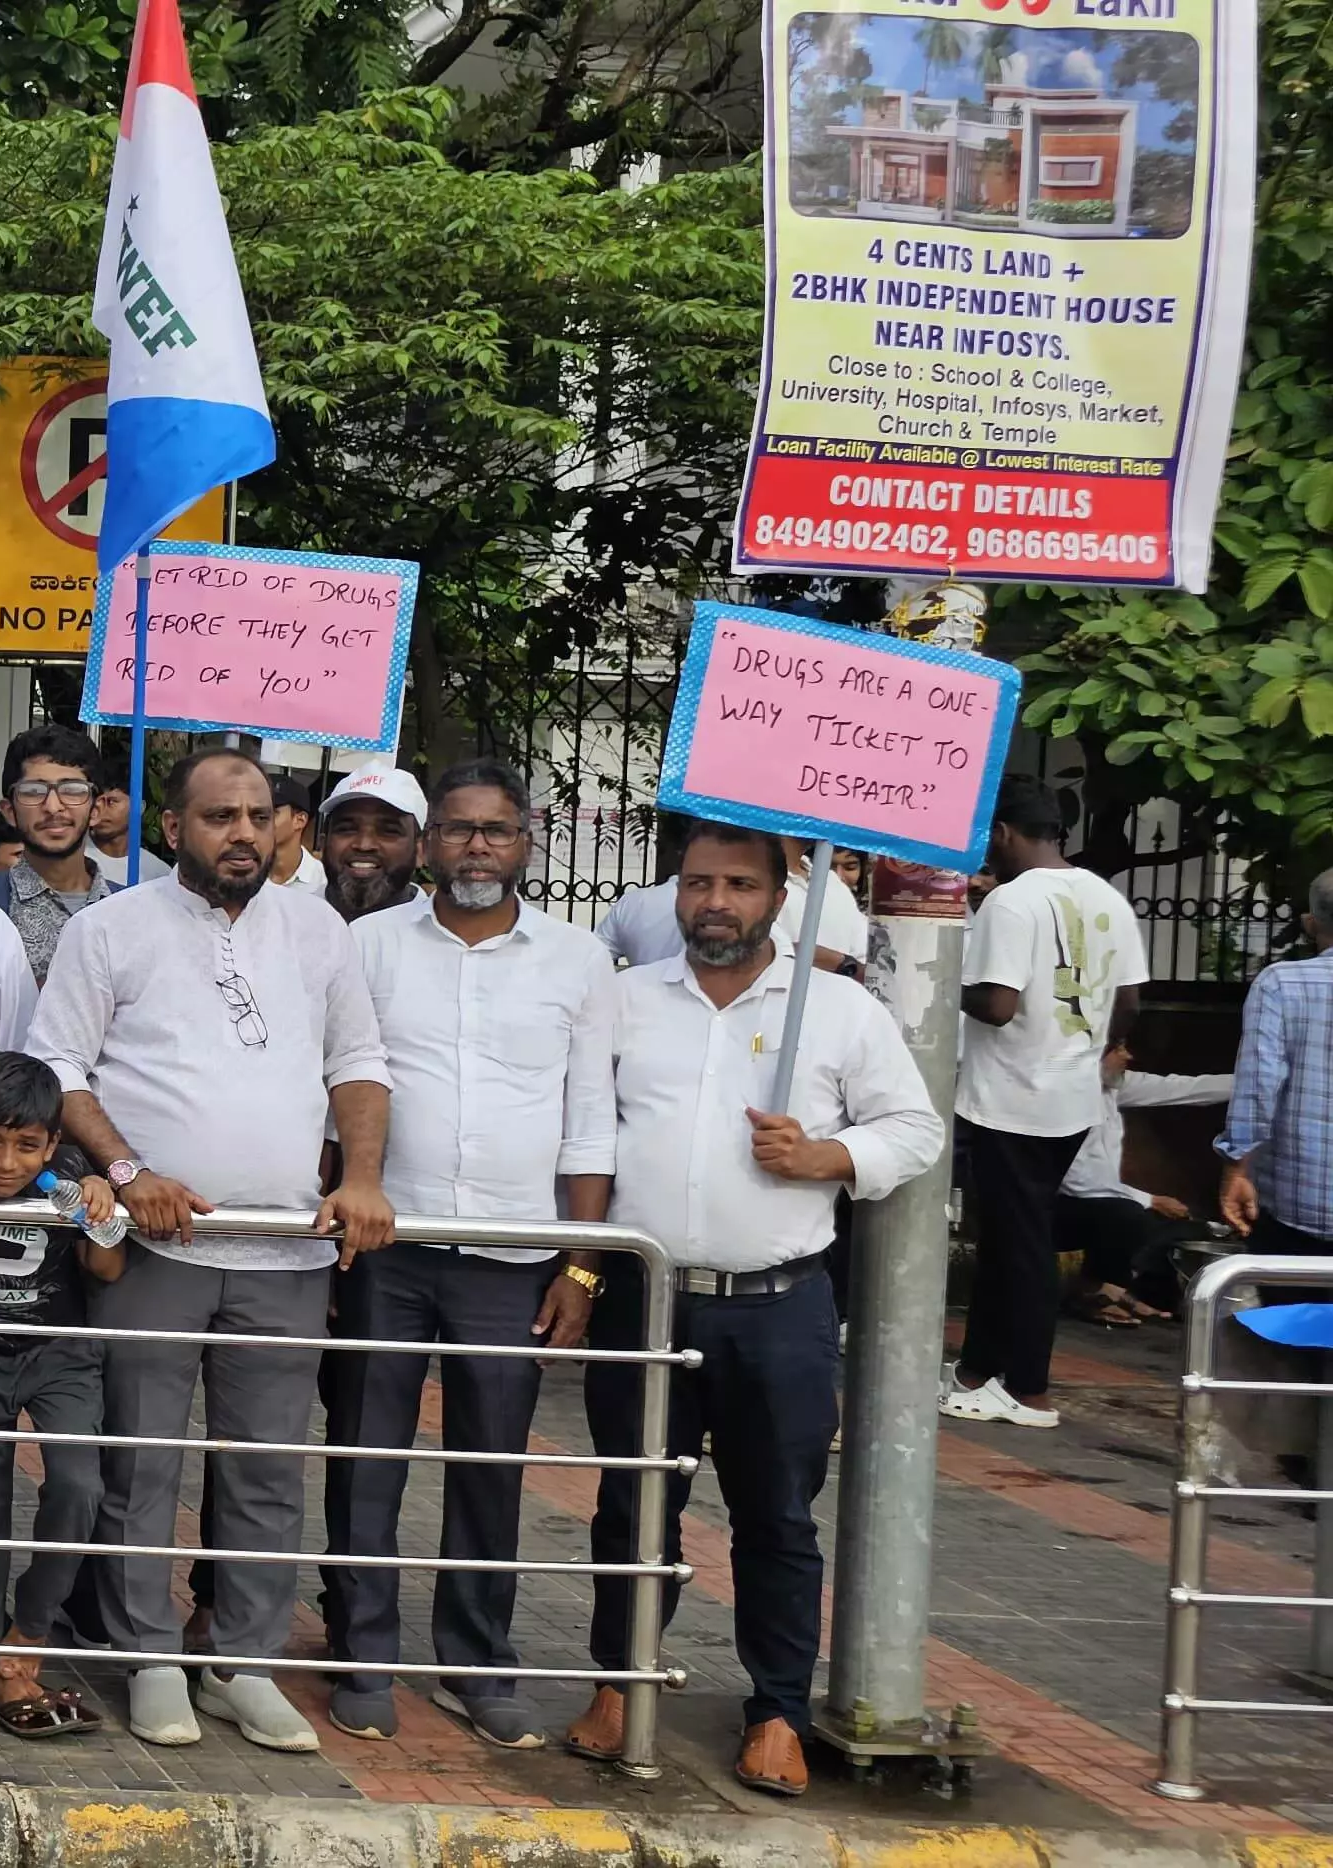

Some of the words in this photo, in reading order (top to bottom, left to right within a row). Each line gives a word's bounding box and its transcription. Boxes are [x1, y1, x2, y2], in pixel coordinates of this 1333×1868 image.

[867, 238, 884, 264] 4
[894, 240, 973, 274] CENTS
[983, 249, 1051, 279] LAND
[791, 273, 868, 304] 2BHK
[876, 279, 1056, 319] INDEPENDENT
[1064, 296, 1176, 325] HOUSE
[874, 320, 944, 351] NEAR
[952, 326, 1070, 361] INFOSYS.
[828, 354, 887, 378] Close
[893, 360, 913, 380] to
[931, 363, 1002, 387] School
[1009, 369, 1025, 389] &
[1033, 370, 1113, 399] College,
[781, 379, 886, 411] University,
[895, 387, 983, 416] Hospital,
[992, 397, 1072, 423] Infosys,
[1079, 402, 1165, 426] Market,
[877, 414, 952, 438] Church
[958, 422, 973, 440] &
[983, 422, 1057, 447] Temple
[766, 435, 810, 456] Loan
[815, 438, 874, 463] Facility
[878, 443, 957, 466] Available
[960, 449, 981, 469] @
[985, 452, 1050, 470] Lowest
[1052, 456, 1117, 473] Interest
[1120, 459, 1164, 476] Rate
[829, 475, 965, 513] CONTACT
[974, 483, 1093, 519] DETAILS
[755, 515, 957, 560] 8494902462,
[967, 528, 1159, 564] 9686695406
[189, 566, 248, 588] RID
[263, 575, 297, 594] OF
[310, 580, 398, 611] DRUGS
[0, 607, 46, 631] NO
[238, 618, 308, 649] THEY
[321, 625, 380, 648] GET
[199, 666, 231, 684] OF
[721, 630, 824, 688] "DRUGS
[839, 666, 889, 696] ARE
[896, 679, 913, 700] A
[720, 694, 783, 728] WAY
[807, 714, 923, 757] TICKET
[934, 740, 969, 770] TO
